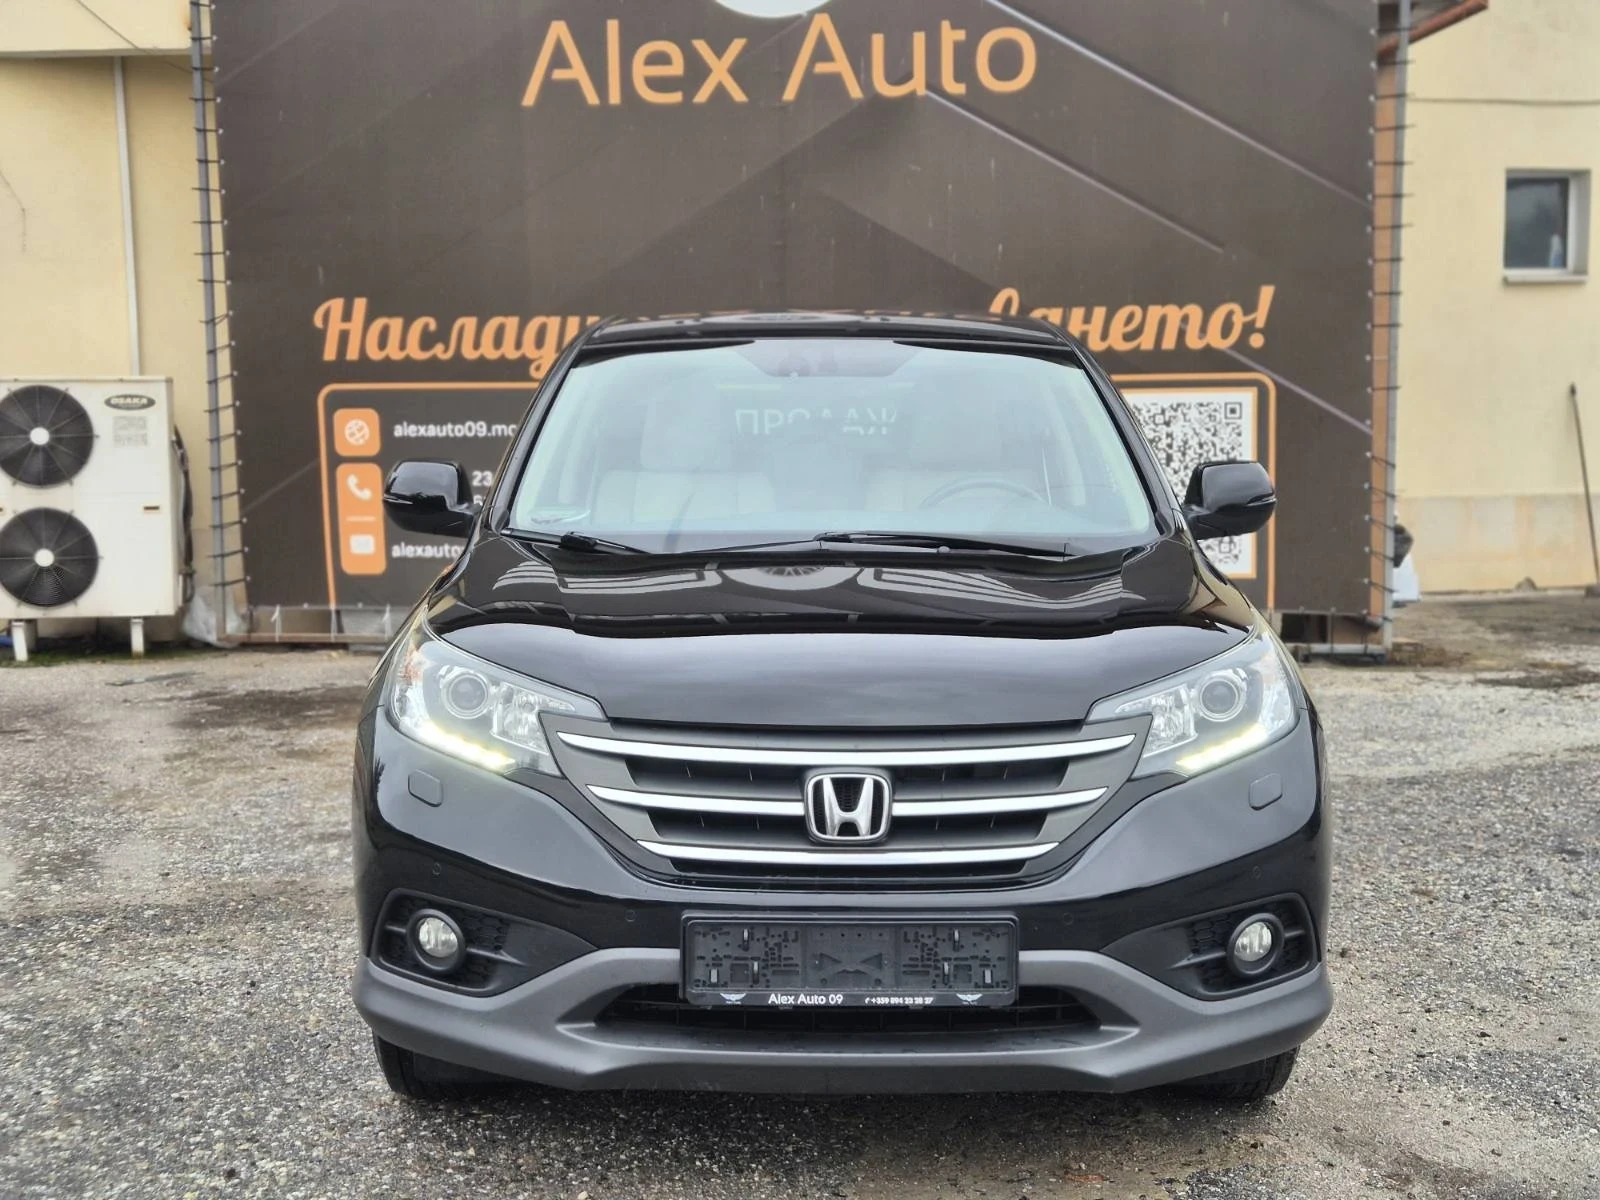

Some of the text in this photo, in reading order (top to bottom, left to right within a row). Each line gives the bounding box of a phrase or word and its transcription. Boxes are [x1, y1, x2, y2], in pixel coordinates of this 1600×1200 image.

[521, 12, 1037, 107] Alex Auto
[391, 542, 466, 558] alexauto
[768, 993, 795, 1005] Alex
[797, 993, 826, 1005] Auto
[828, 993, 844, 1005] 09
